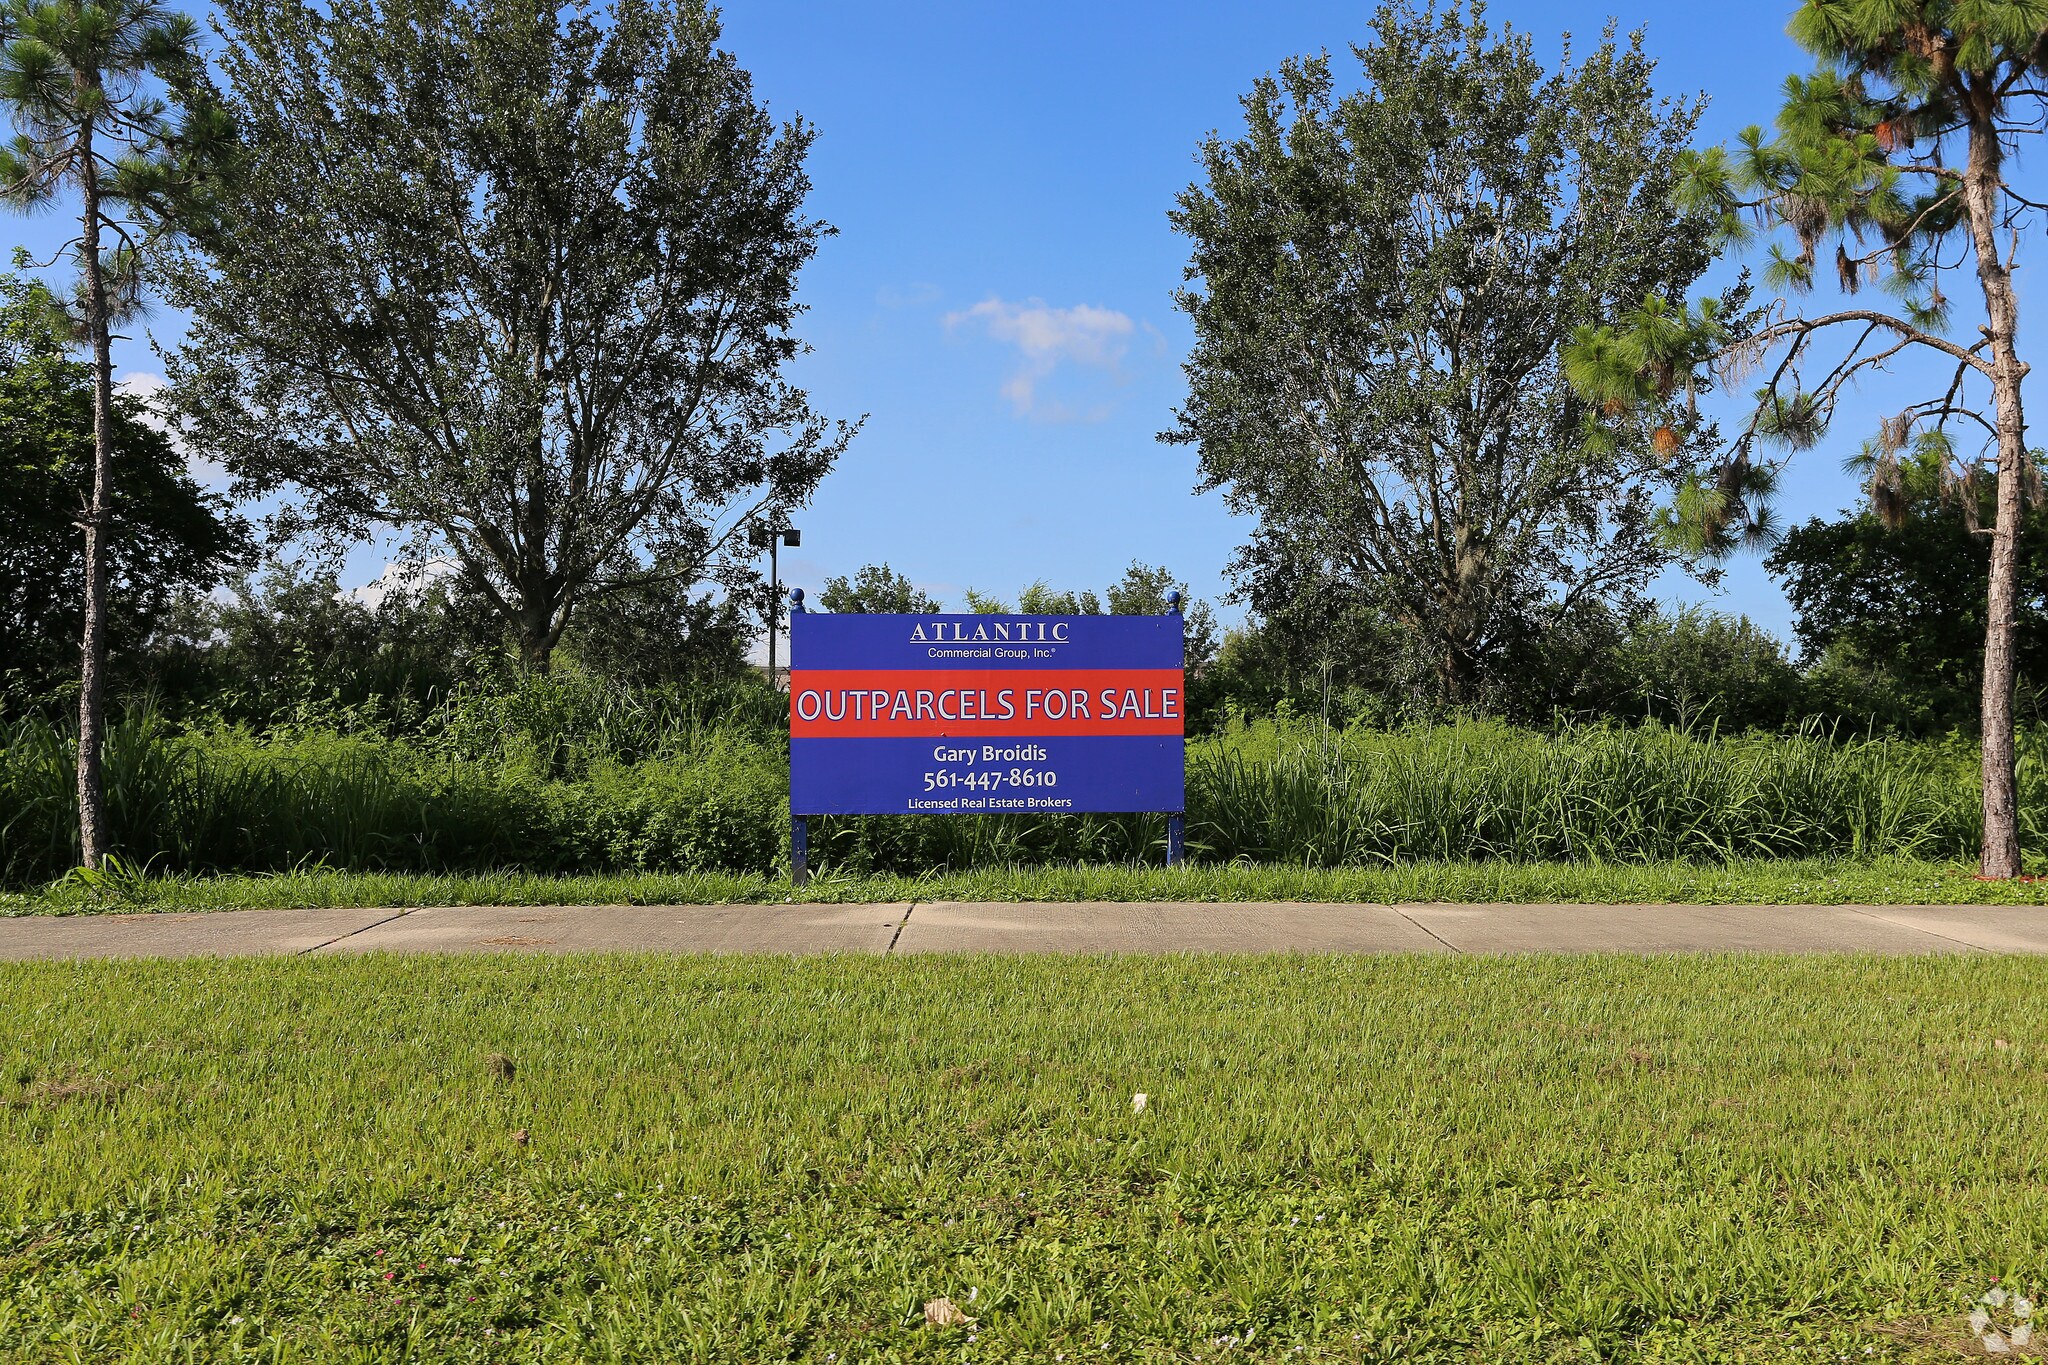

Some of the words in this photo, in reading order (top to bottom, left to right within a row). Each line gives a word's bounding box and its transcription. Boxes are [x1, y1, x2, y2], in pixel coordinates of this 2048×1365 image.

[909, 622, 1069, 641] ATLANTIC
[927, 647, 991, 659] Commercial
[994, 647, 1030, 660] Group,
[796, 690, 1015, 721] OUTPARCELS
[1026, 689, 1090, 720] FOR
[1099, 688, 1178, 719] SALE
[933, 745, 977, 766] Gary
[982, 744, 1047, 762] Broidis
[923, 768, 1057, 792] 561-447-8610
[908, 798, 958, 809] Licensed
[961, 798, 986, 809] Real
[989, 798, 1025, 808] Estate
[1027, 797, 1072, 808] Brokers
